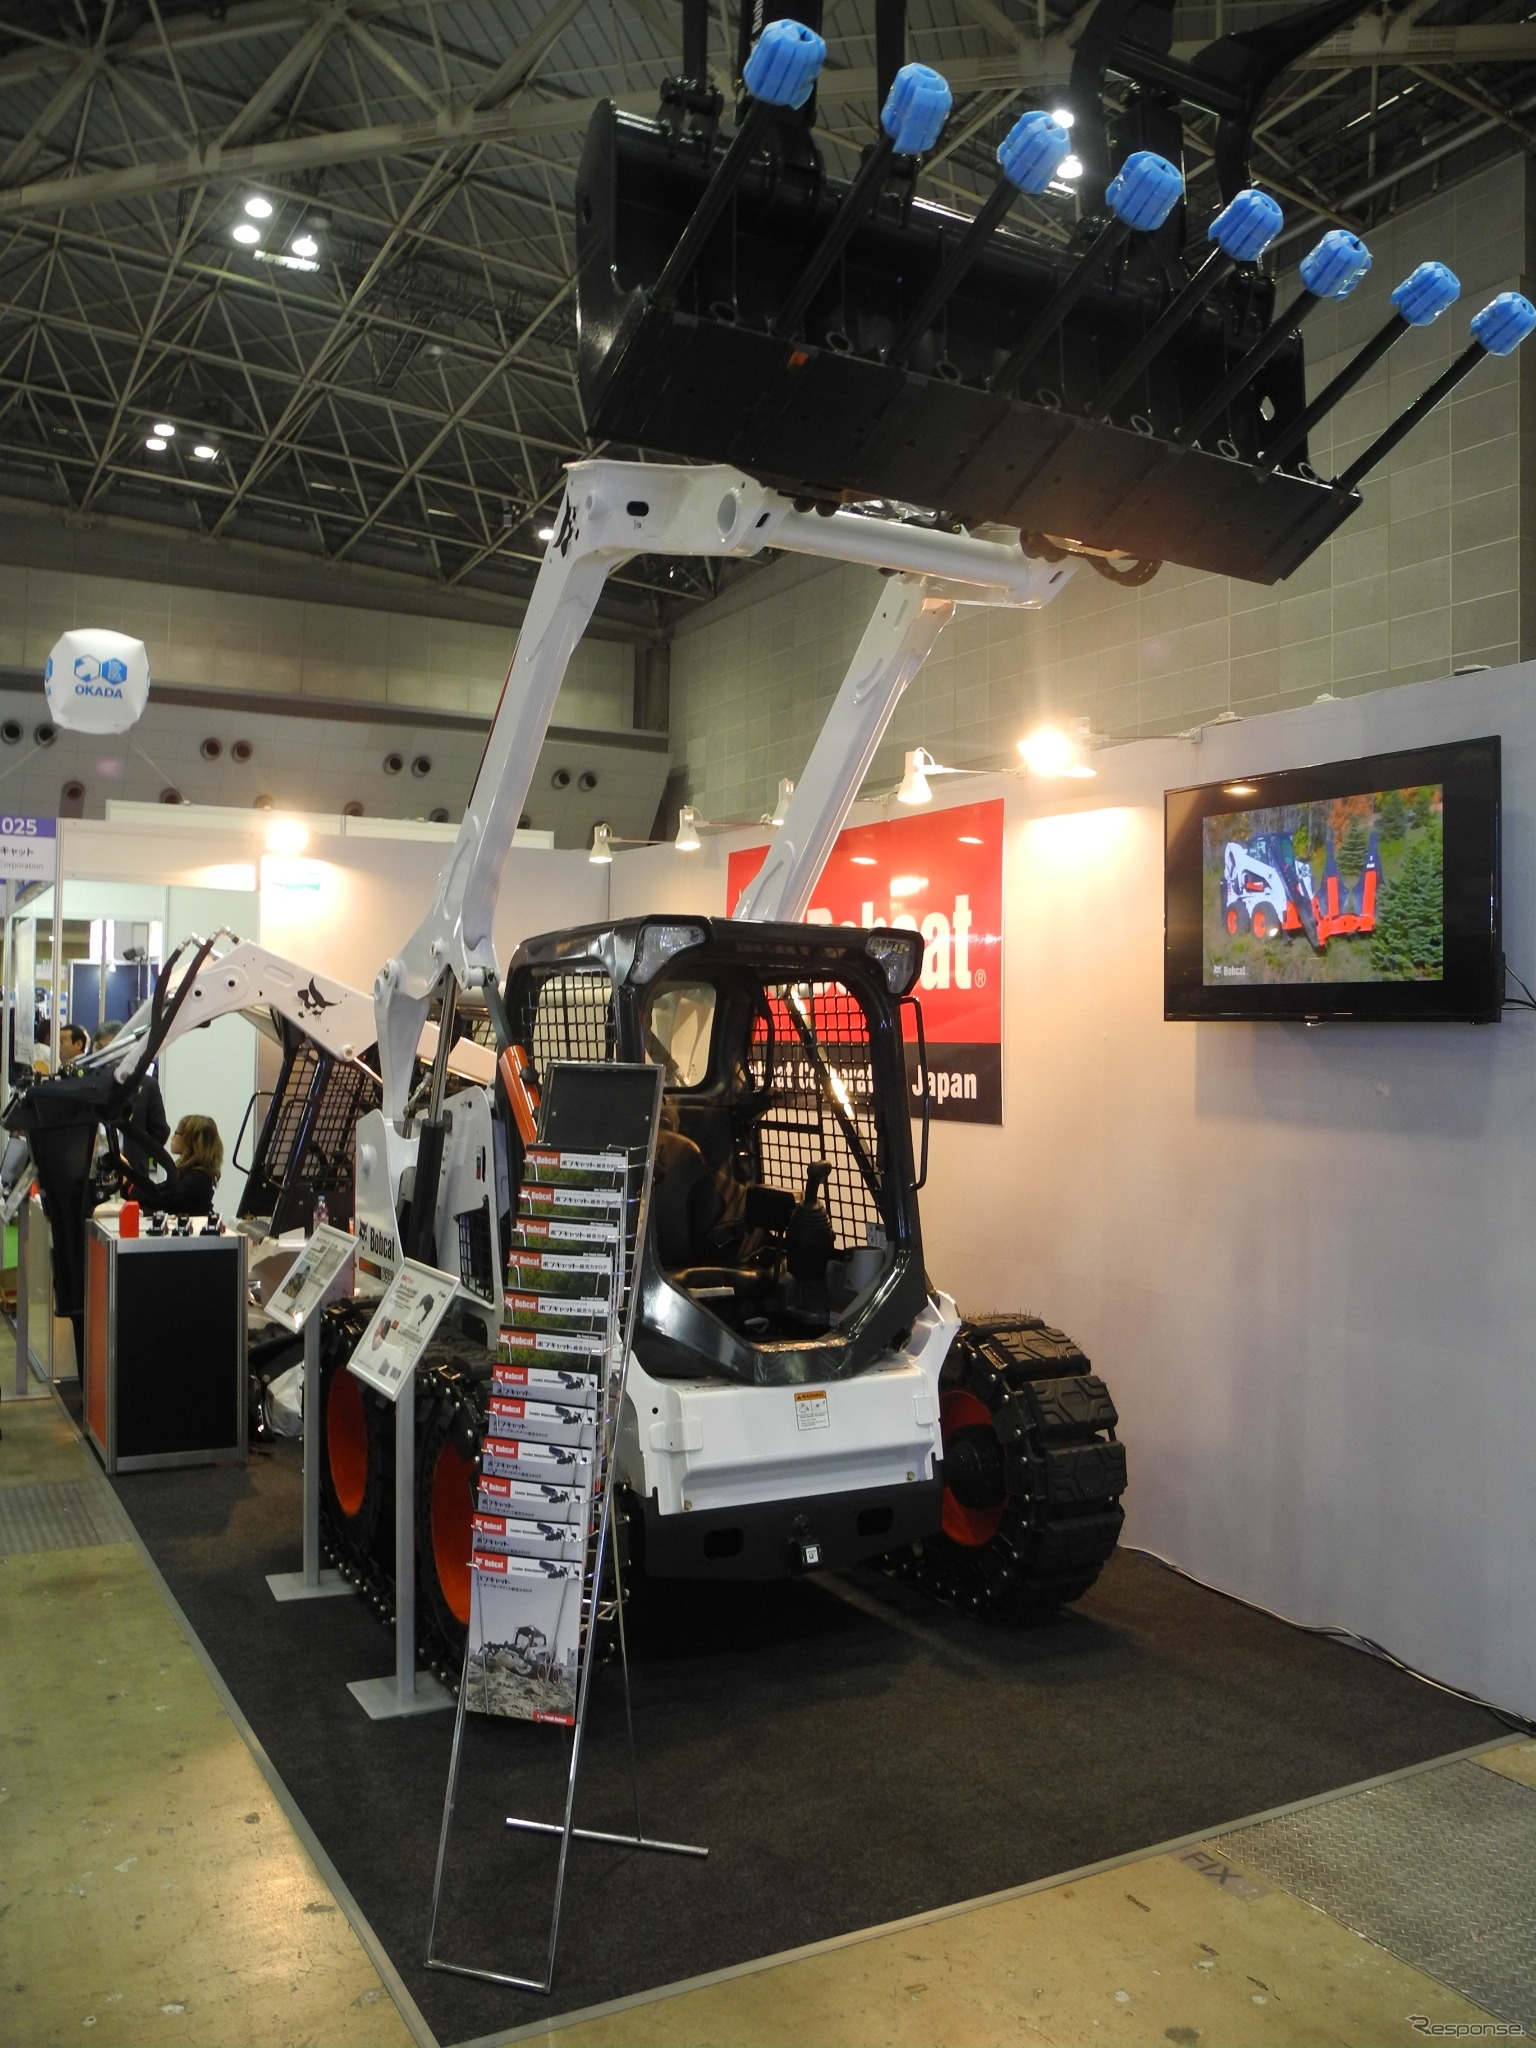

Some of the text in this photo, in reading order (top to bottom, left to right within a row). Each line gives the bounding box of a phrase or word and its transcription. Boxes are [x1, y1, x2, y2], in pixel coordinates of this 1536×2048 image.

[75, 684, 123, 699] OKADA
[2, 816, 37, 836] 025
[0, 861, 43, 870] orporation
[1223, 965, 1246, 977] Bobcat
[911, 1064, 977, 1105] Japan
[536, 1155, 558, 1166] Bobcat
[531, 1191, 552, 1201] Bobcat
[526, 1224, 547, 1235] Bobcat
[370, 1226, 395, 1263] Bobcat
[520, 1255, 540, 1266] Bobcat
[515, 1299, 536, 1310] Bobcat
[511, 1336, 533, 1346] Bobcat
[504, 1372, 524, 1381] Bobcat
[501, 1404, 521, 1414] Bobcat
[495, 1445, 515, 1455] Bobcat
[489, 1483, 507, 1493] Bobcat
[483, 1521, 502, 1531] Bobcat
[484, 1559, 504, 1569] Bobcat
[1180, 1851, 1242, 1885] FIX
